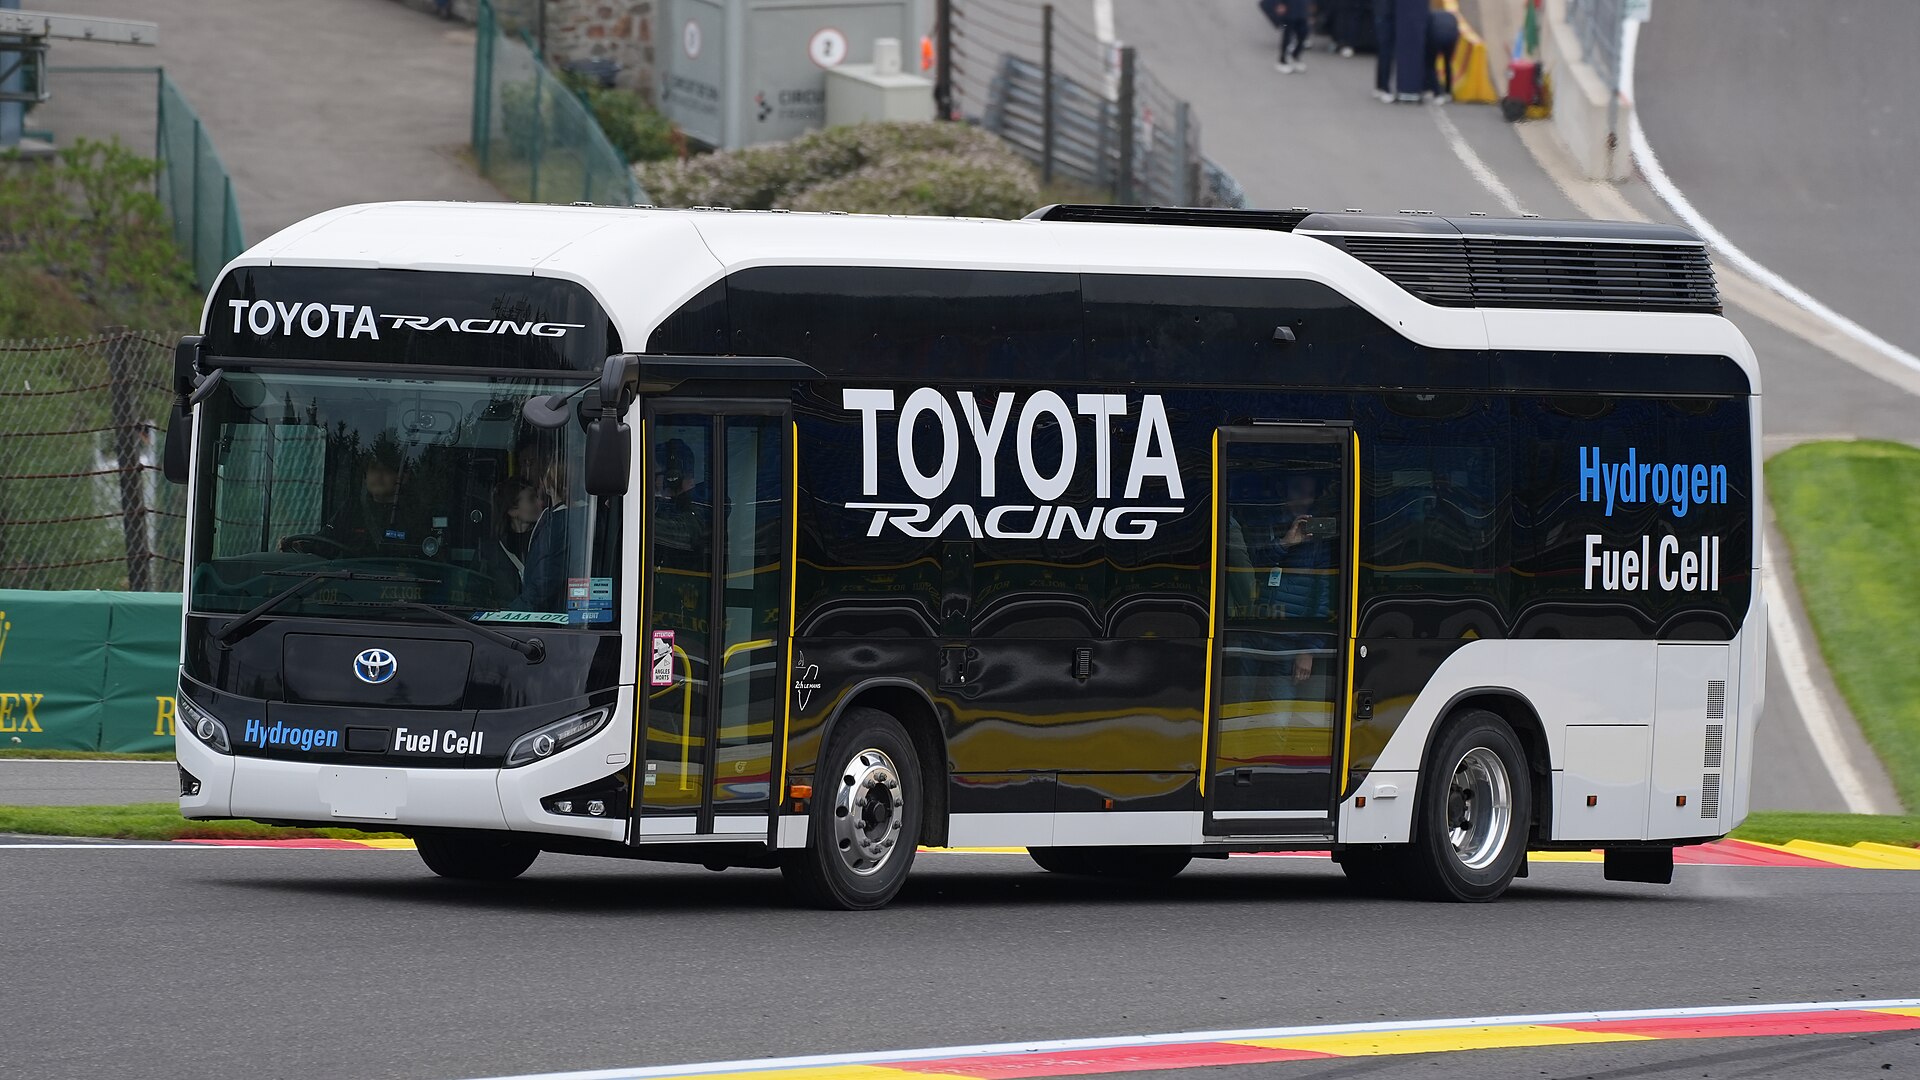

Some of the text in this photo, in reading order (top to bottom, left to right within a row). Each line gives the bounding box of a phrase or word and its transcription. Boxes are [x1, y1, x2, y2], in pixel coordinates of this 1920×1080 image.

[228, 299, 586, 340] TOYOTA RACING
[842, 386, 1186, 501] TOYOTA
[1579, 446, 1728, 518] Hydrogen
[844, 502, 1185, 540] RACING
[1584, 534, 1719, 591] Fuel Cell
[244, 718, 338, 751] Hydrogen
[394, 727, 484, 755] Fuel Cell
